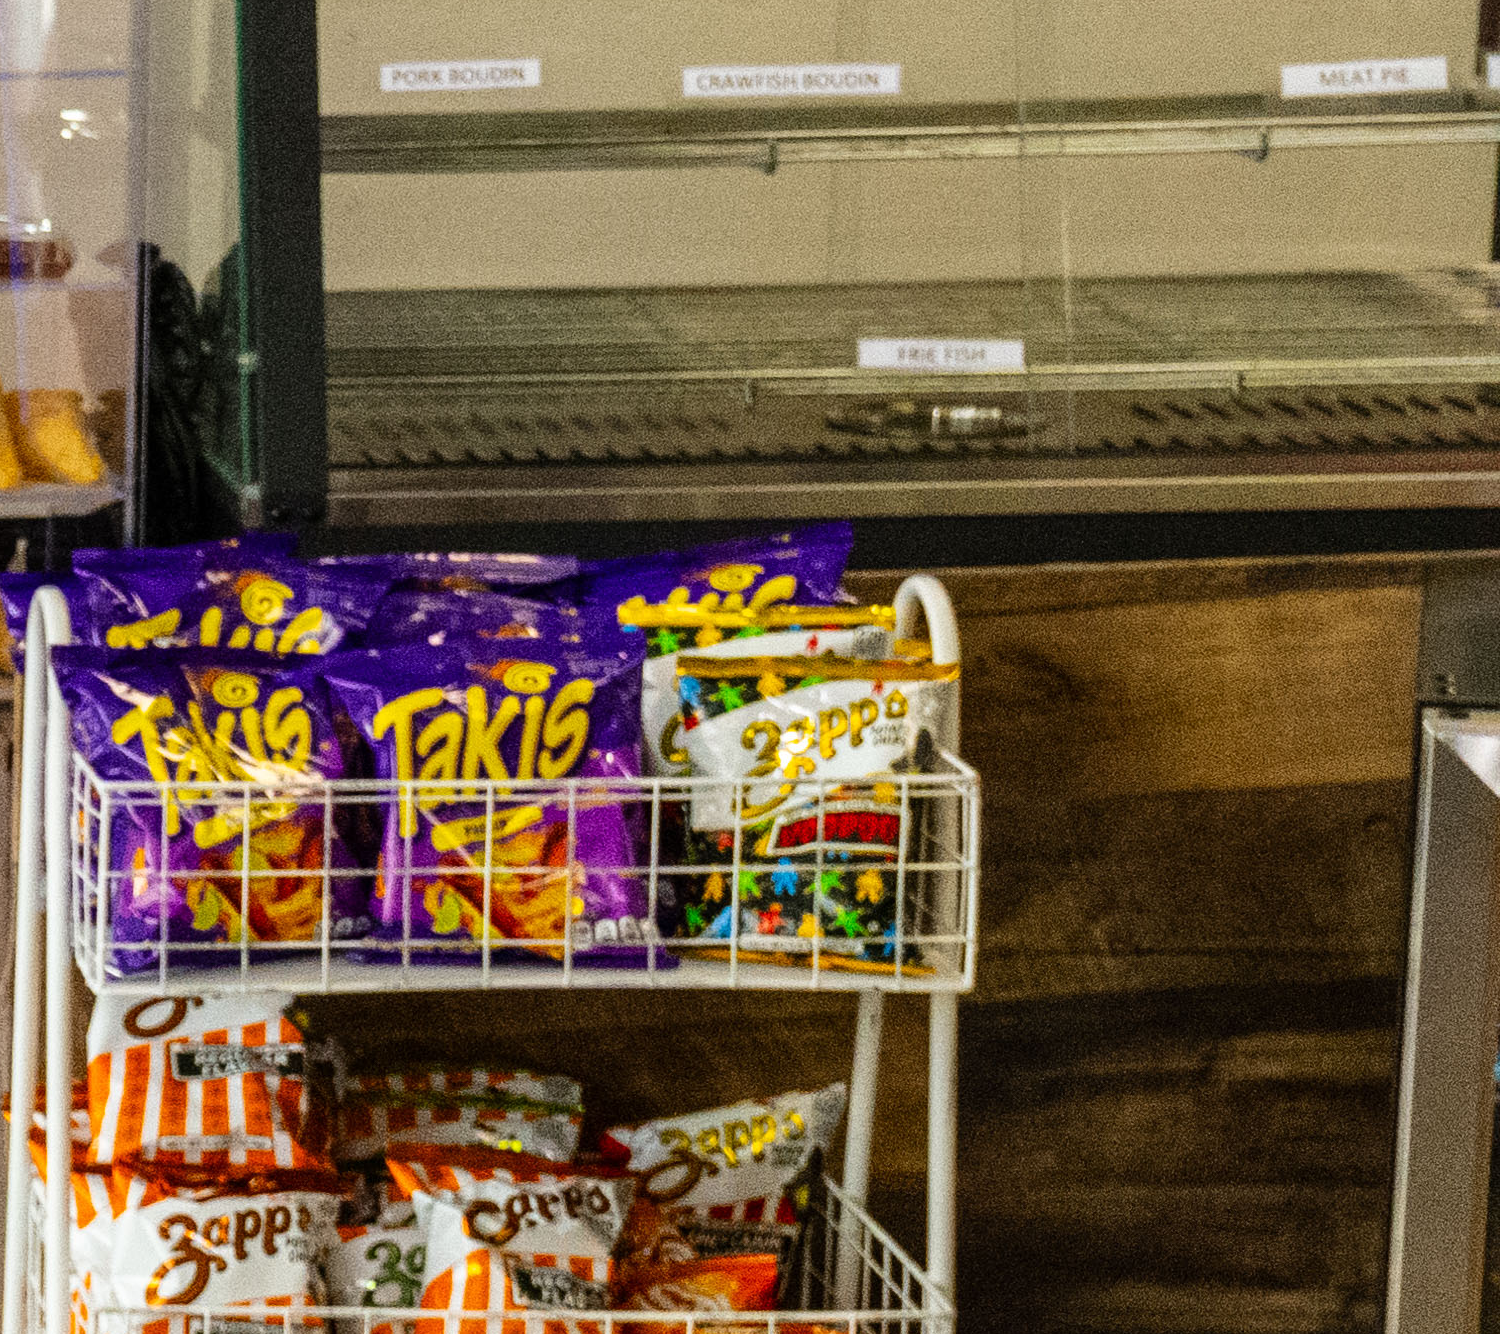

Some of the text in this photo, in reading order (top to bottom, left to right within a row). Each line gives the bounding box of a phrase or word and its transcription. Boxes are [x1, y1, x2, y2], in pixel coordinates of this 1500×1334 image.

[390, 67, 526, 86] PORK BOUDIN
[695, 71, 880, 90] CRAWFISH BOUDIN
[372, 662, 596, 838] Takis
